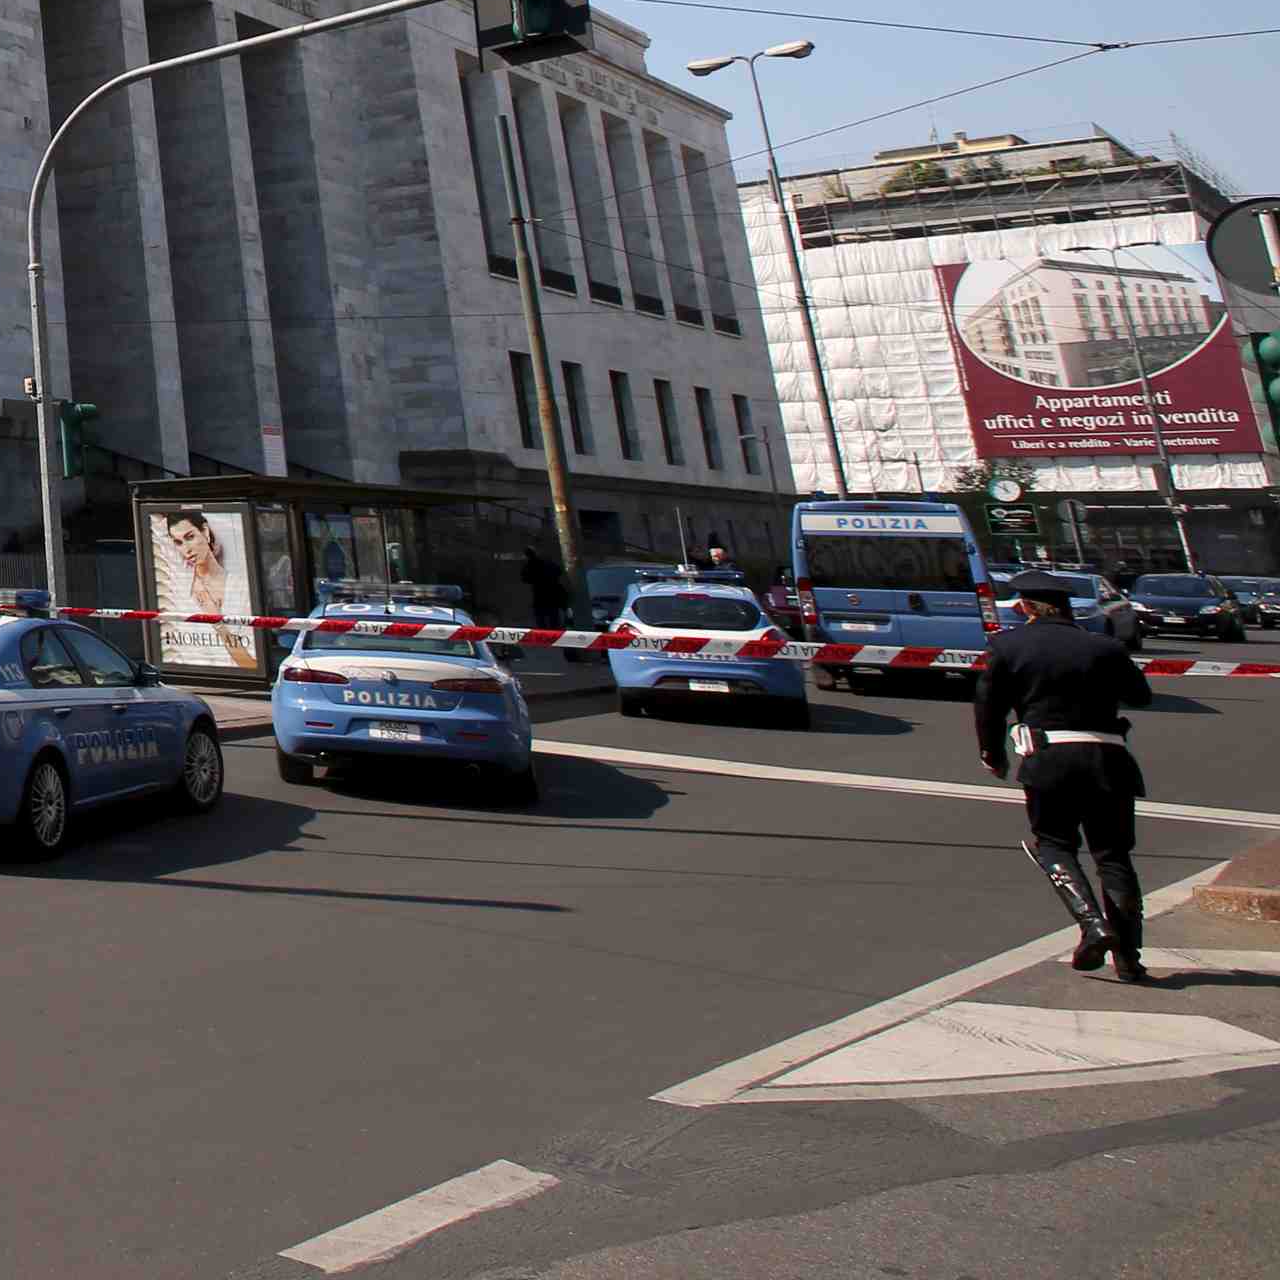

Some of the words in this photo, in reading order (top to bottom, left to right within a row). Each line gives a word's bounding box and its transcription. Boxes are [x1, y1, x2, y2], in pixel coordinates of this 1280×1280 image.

[983, 414, 1035, 430] uffici
[1040, 417, 1053, 428] e
[1058, 411, 1125, 431] negozi
[1131, 410, 1154, 426] in
[1158, 408, 1240, 425] vendita
[1011, 439, 1044, 449] Liberi
[1068, 437, 1111, 448] reddito
[1123, 437, 1156, 447] Varie
[836, 517, 929, 531] POLIZIA
[171, 630, 252, 649] MORELLATO
[342, 689, 438, 709] POLIZIA
